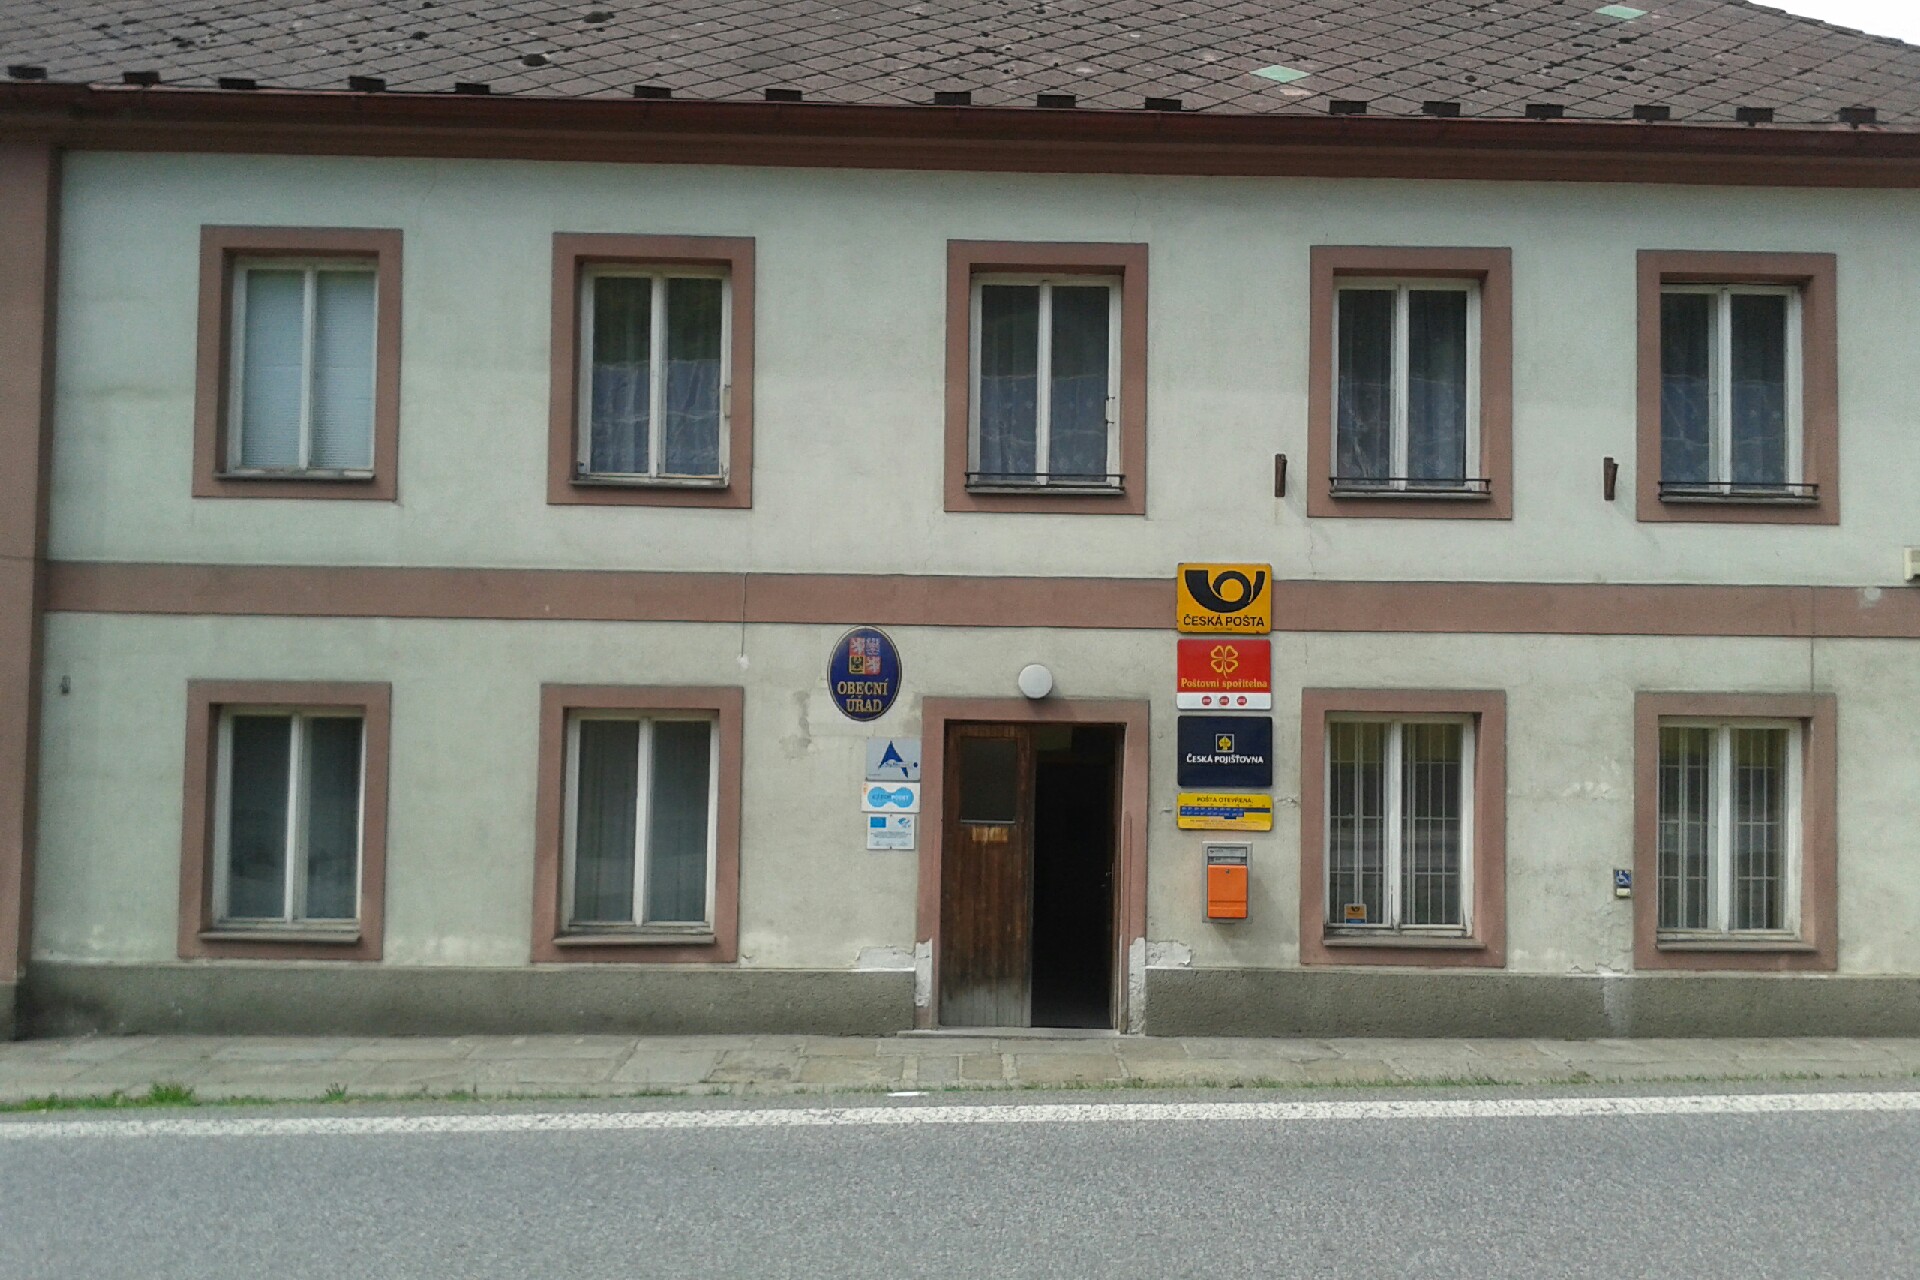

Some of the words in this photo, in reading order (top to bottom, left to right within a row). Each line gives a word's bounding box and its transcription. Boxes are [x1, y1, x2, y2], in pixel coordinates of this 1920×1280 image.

[1183, 613, 1223, 627] ČESKÁ
[1225, 614, 1265, 627] POŠTA
[837, 678, 889, 696] OBECNÍ
[1181, 677, 1220, 688] Poštovní
[1222, 678, 1268, 690] spořitelna
[846, 695, 882, 712] ÚŘAD
[1186, 752, 1213, 763] ČESKÁ
[1196, 795, 1217, 803] POŠTA
